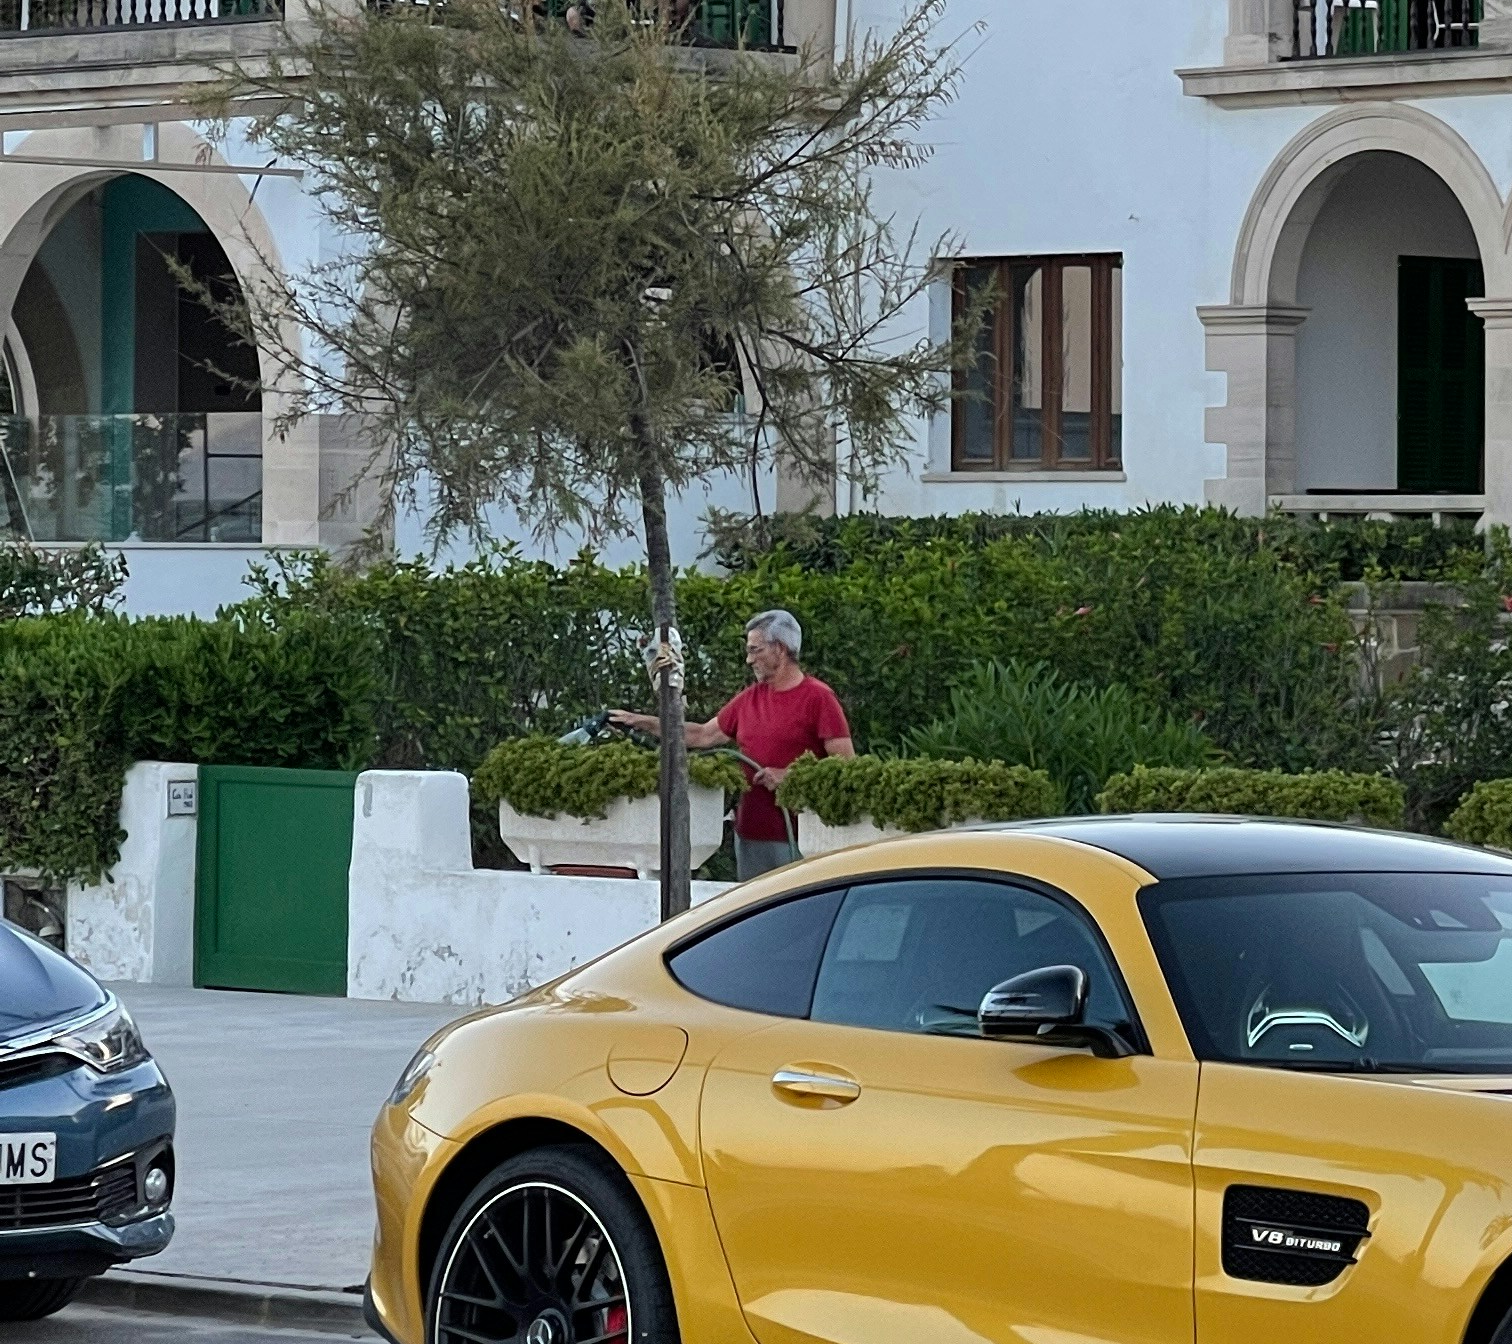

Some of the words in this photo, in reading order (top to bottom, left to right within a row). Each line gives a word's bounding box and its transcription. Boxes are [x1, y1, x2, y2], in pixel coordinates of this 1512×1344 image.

[0, 1142, 48, 1178] MS
[1251, 1228, 1284, 1245] V8
[1285, 1237, 1341, 1252] BITURBO
